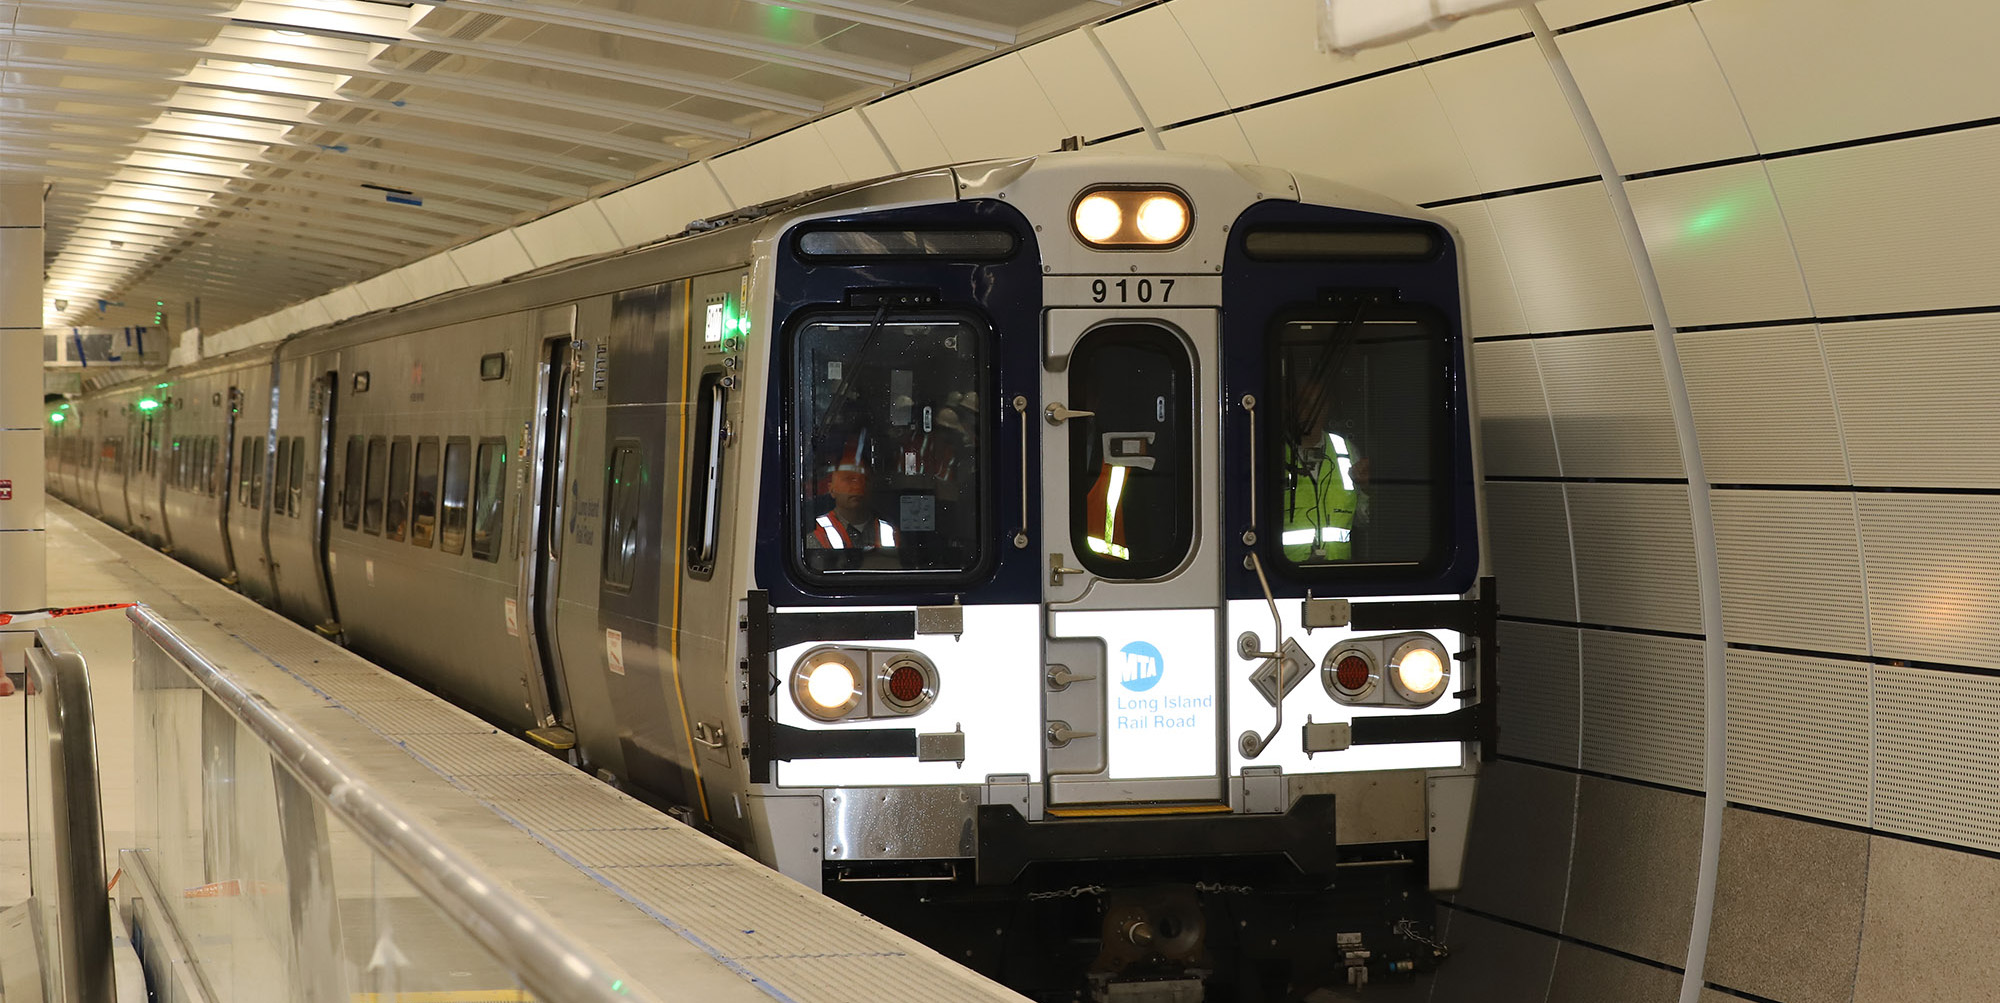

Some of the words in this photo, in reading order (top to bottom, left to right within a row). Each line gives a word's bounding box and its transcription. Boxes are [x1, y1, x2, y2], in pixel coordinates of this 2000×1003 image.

[1092, 279, 1175, 303] 9107
[1119, 651, 1157, 683] MTA
[1117, 697, 1158, 713] Long
[1164, 694, 1212, 709] Island
[1117, 715, 1148, 729] Rail
[1154, 714, 1196, 728] Road
